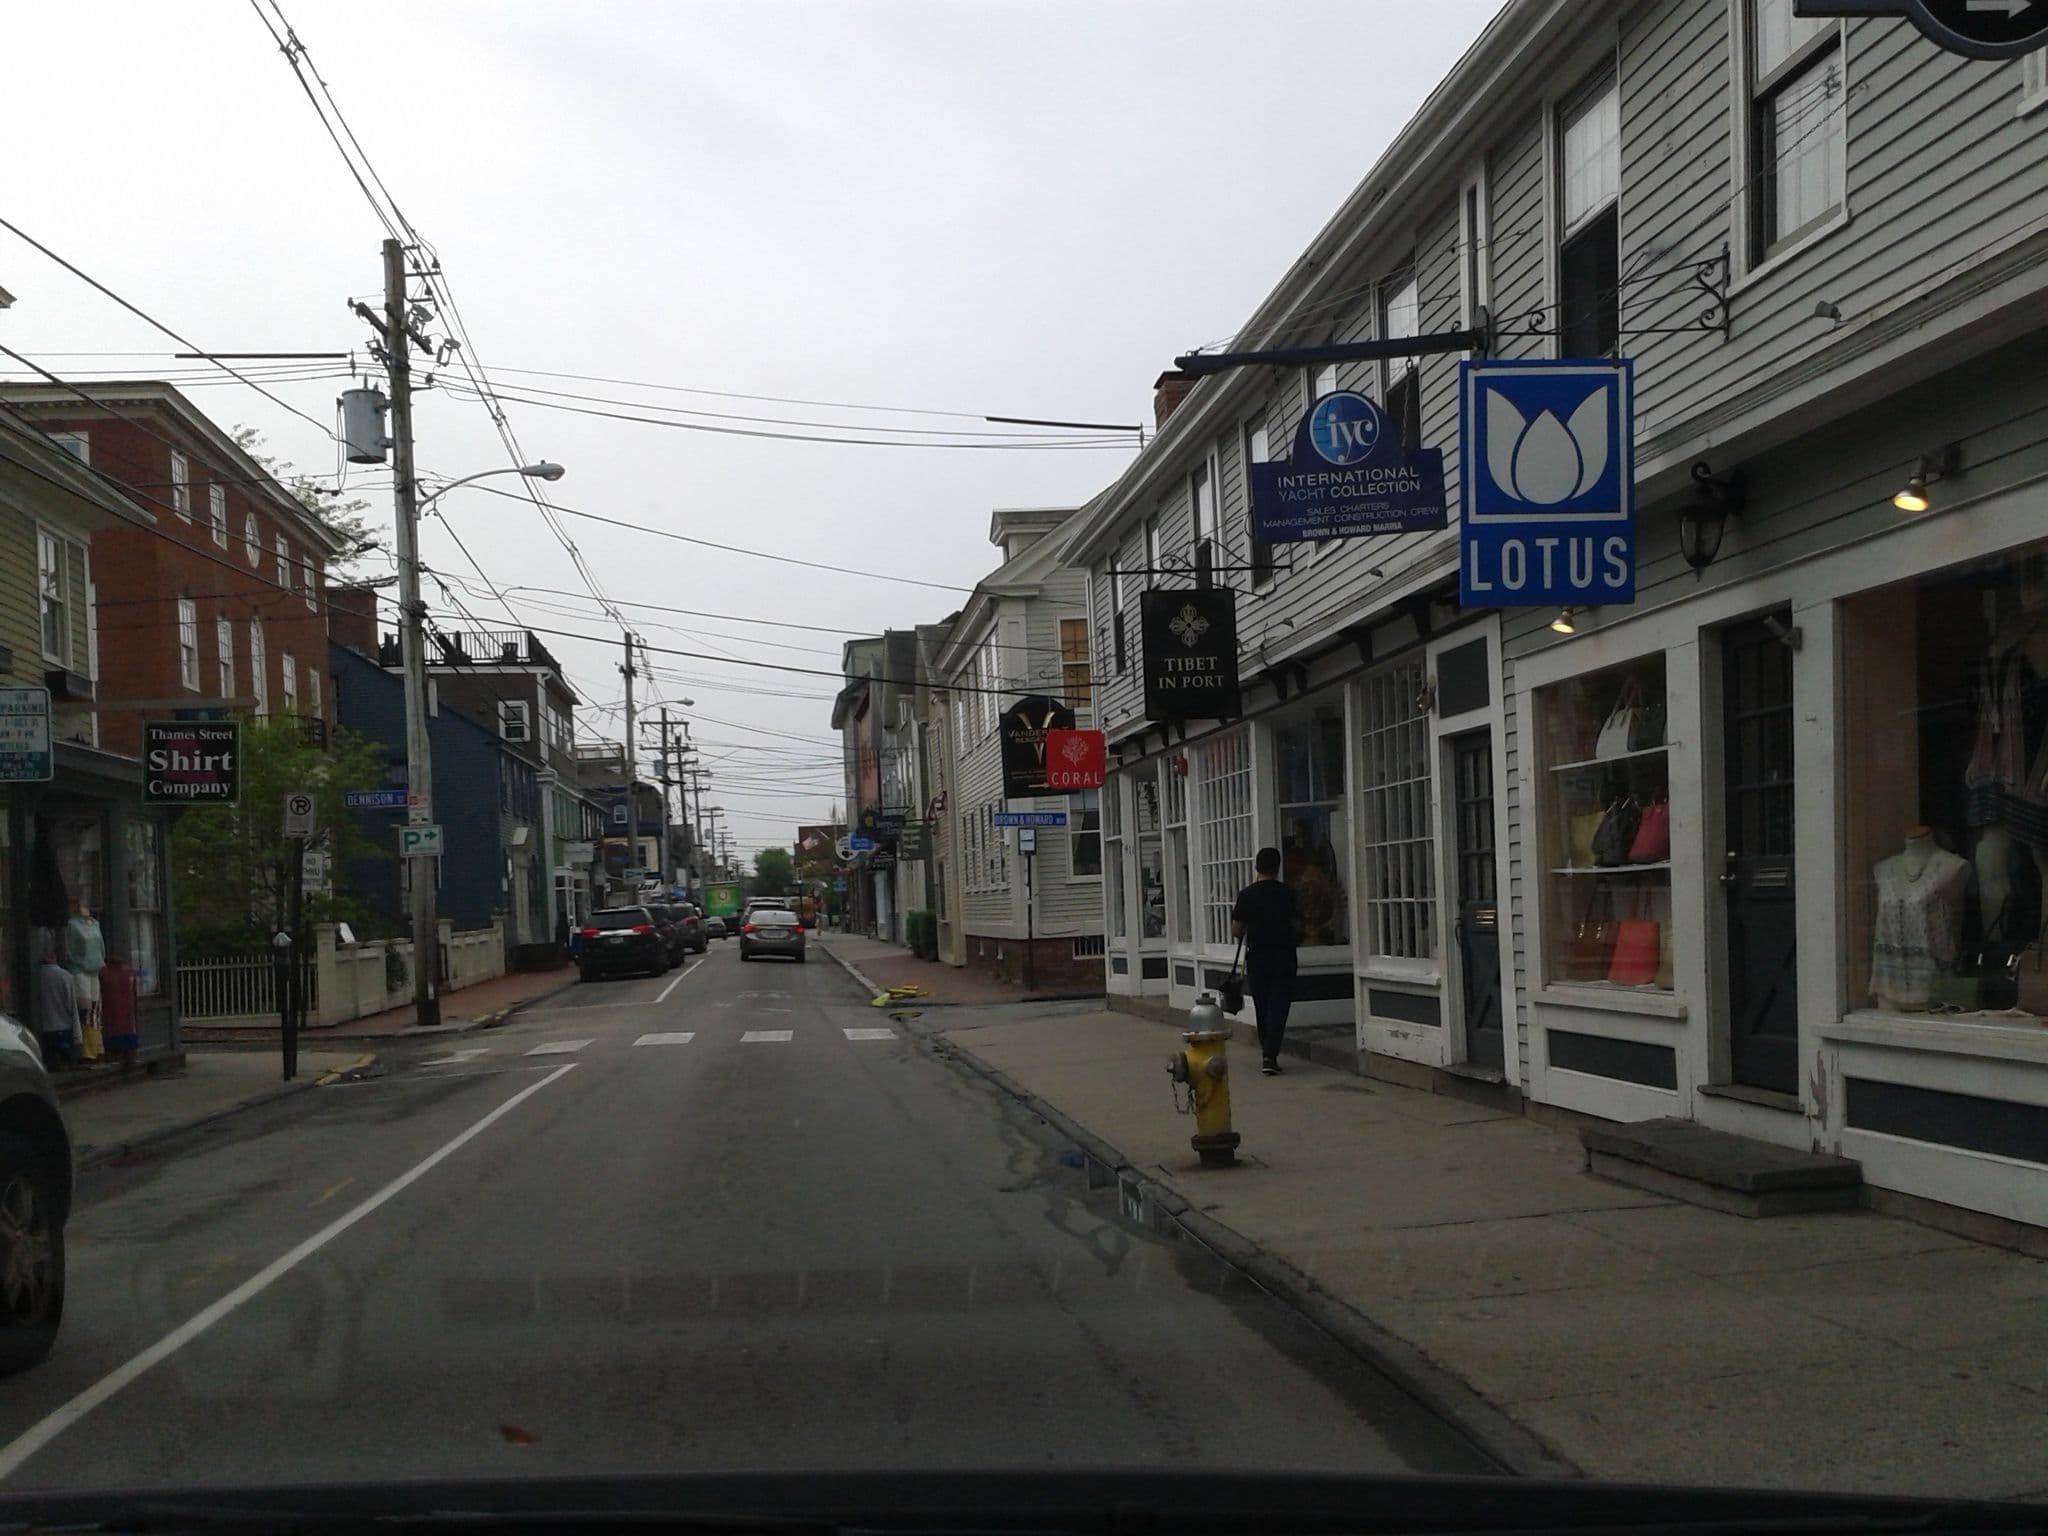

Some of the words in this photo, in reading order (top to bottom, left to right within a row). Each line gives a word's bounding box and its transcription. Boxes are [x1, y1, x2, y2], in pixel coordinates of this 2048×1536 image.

[1278, 466, 1420, 488] INTERNATIONAL
[1278, 487, 1327, 502] YACHT
[1330, 480, 1421, 499] COLLECTION
[1263, 515, 1330, 528] MANAGEMENT
[1334, 510, 1407, 523] CONSTRUCTION
[1410, 506, 1440, 516] CREW
[1306, 506, 1336, 517] SALES
[1340, 501, 1390, 513] CHARTERS
[1302, 528, 1330, 538] BROWN
[1339, 524, 1371, 535] HOWARD
[1470, 536, 1628, 591] LOTUS
[1163, 656, 1218, 672] TIBET
[1158, 676, 1176, 689] IN
[1182, 674, 1225, 688] PORT
[149, 728, 196, 740] Thames
[199, 728, 233, 740] Street
[149, 749, 233, 771] Shirt
[1051, 771, 1102, 785] CORAL
[149, 780, 231, 798] Company
[347, 794, 393, 806] DENNISON
[1025, 814, 1054, 825] HOWARD
